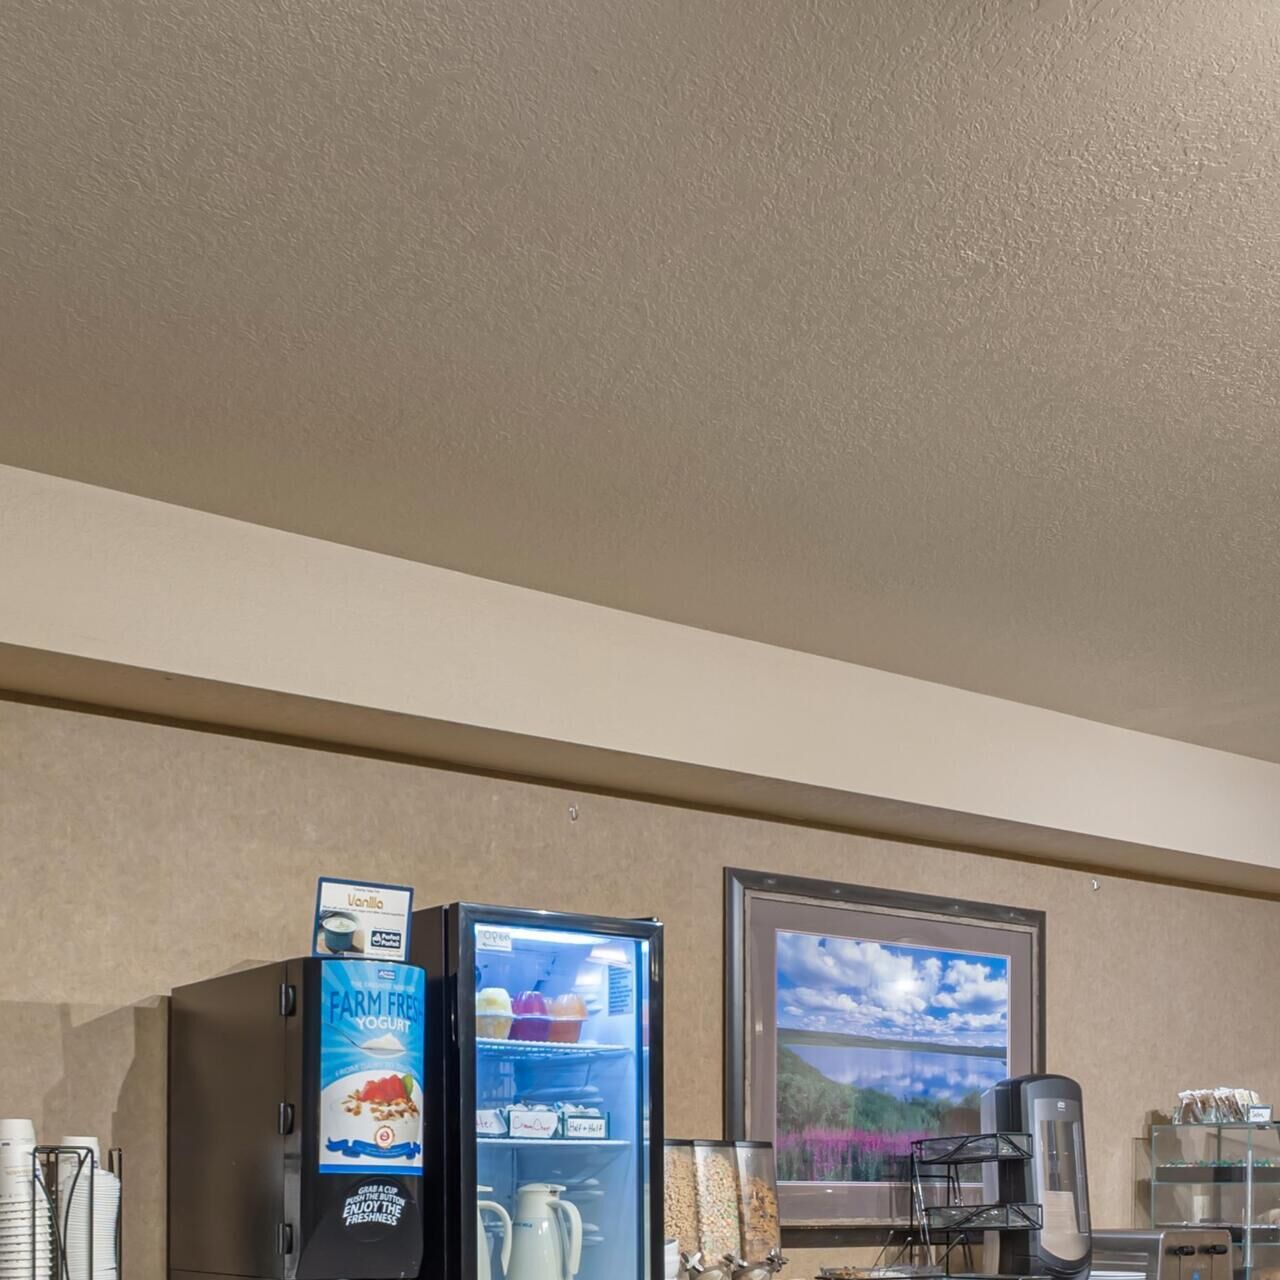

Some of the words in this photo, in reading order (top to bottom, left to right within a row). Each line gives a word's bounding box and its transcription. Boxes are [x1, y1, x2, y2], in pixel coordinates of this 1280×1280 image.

[347, 893, 384, 909] Vanilla
[381, 933, 400, 941] Perfect
[330, 990, 382, 1024] FARM
[356, 1016, 412, 1034] YOGURT
[358, 1185, 379, 1194] GRAB
[379, 1185, 384, 1193] A
[384, 1185, 399, 1194] CUP
[345, 1194, 365, 1206] PUSH
[379, 1192, 406, 1206] BUTTON
[342, 1201, 380, 1218] ENJOY
[381, 1201, 402, 1218] THE
[345, 1212, 398, 1226] FRESHNESS
